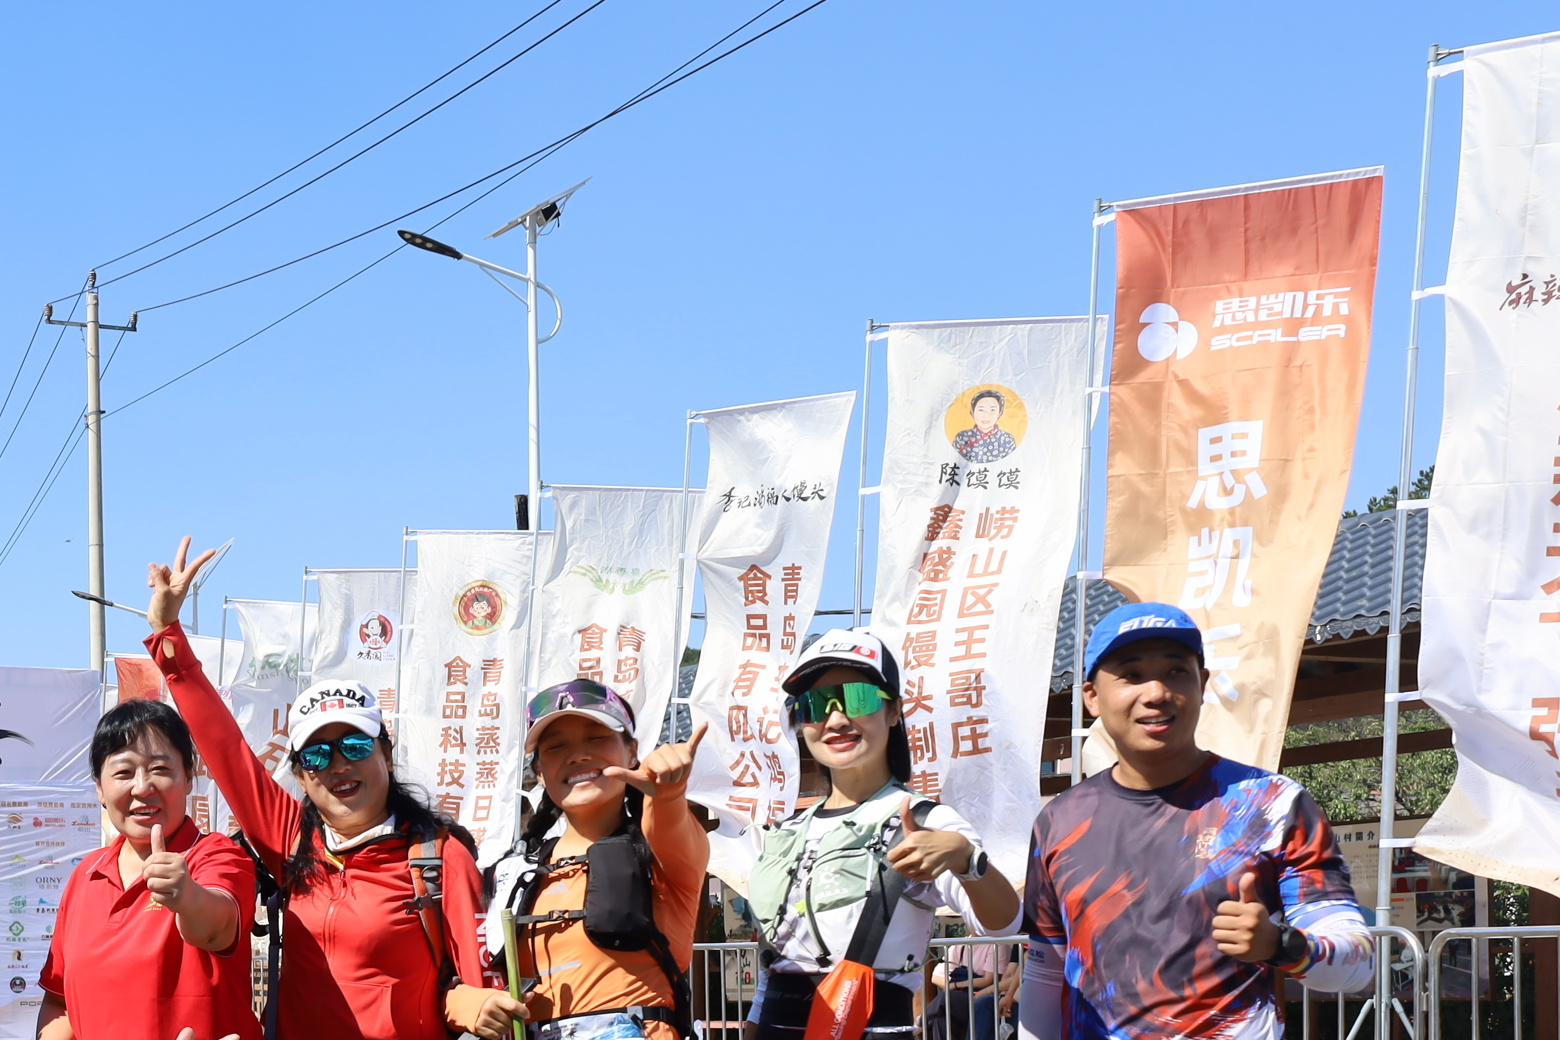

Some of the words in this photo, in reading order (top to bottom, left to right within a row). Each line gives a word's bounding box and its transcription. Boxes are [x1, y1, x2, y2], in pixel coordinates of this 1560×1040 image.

[1212, 286, 1352, 328] 思凯乐
[939, 462, 1022, 491] 陈馍馍
[946, 505, 1020, 761] 崂山区王哥庄
[576, 622, 608, 686] 食品
[299, 688, 367, 716] CANADA
[35, 876, 63, 884] ORNY
